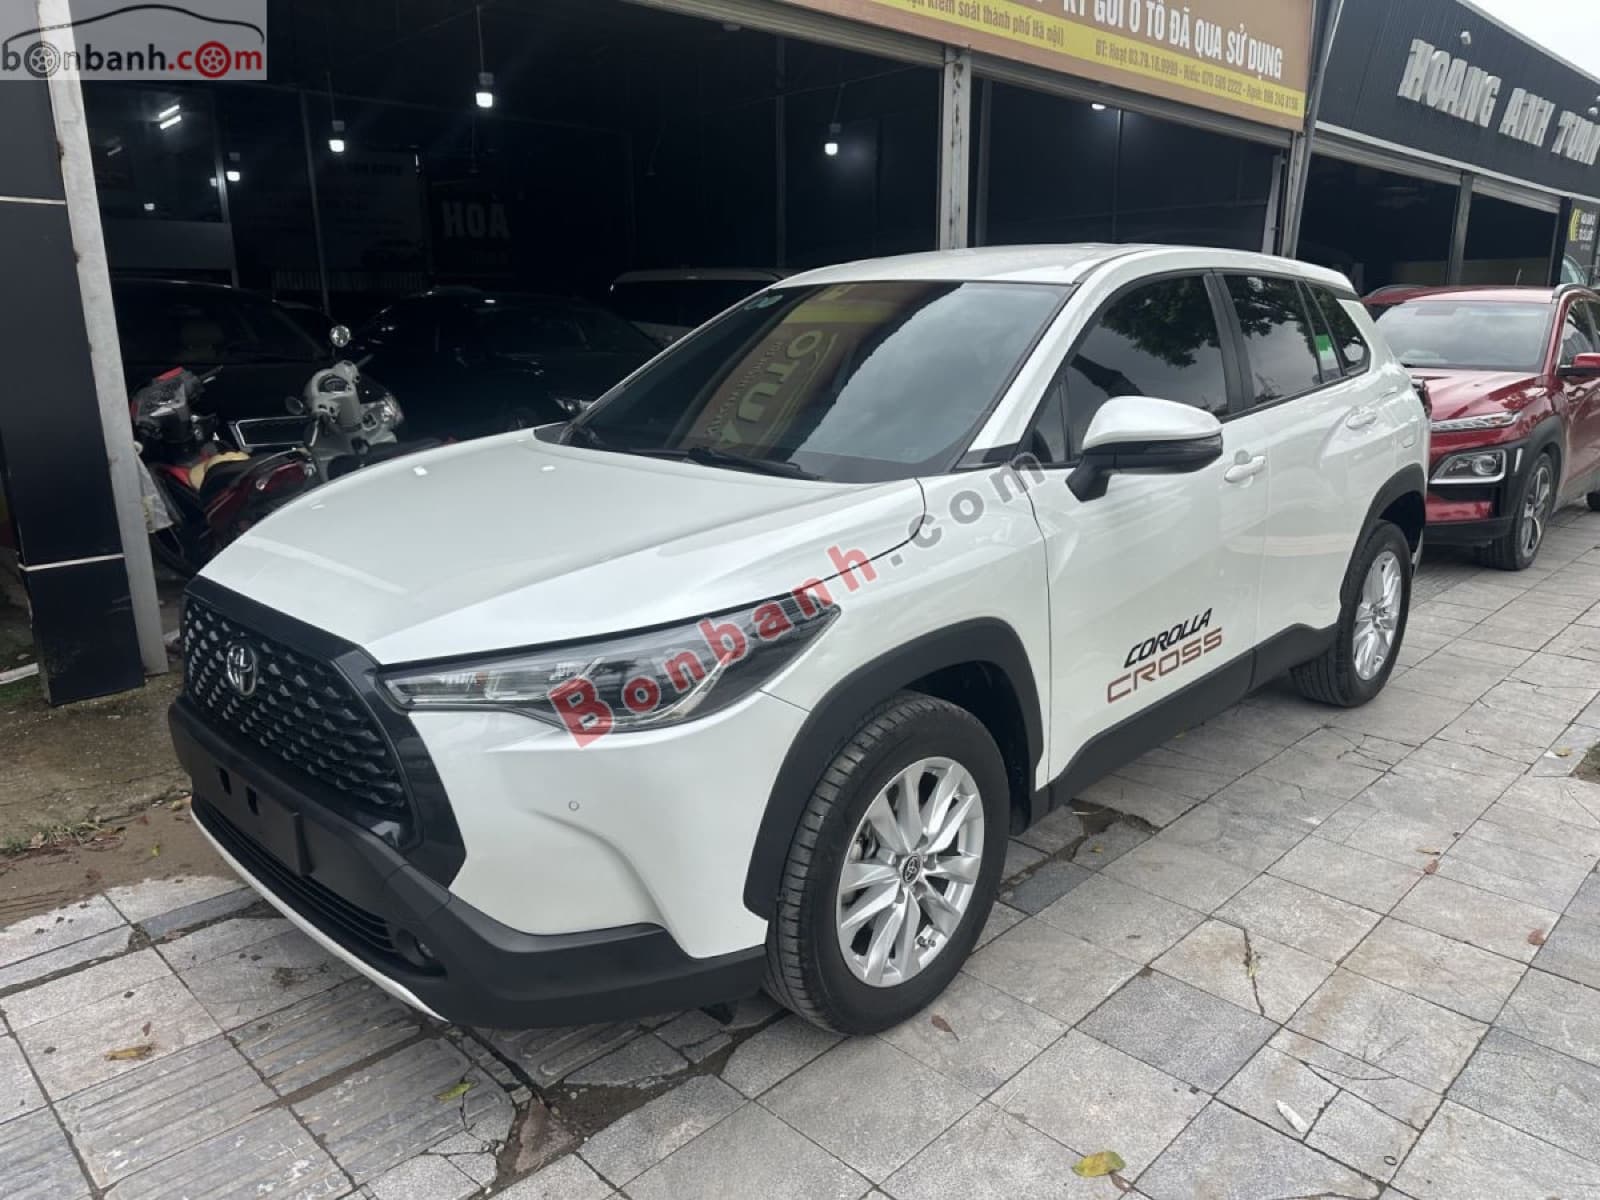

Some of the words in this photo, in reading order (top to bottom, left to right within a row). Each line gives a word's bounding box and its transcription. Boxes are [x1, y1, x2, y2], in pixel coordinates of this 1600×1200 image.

[1169, 6, 1190, 49] ĐÃ
[1195, 18, 1222, 60] QUA
[1226, 23, 1248, 66] SỬ
[1248, 38, 1283, 80] DỤNG
[1397, 39, 1502, 128] HOANG
[1498, 87, 1556, 148] ANH
[1107, 627, 1222, 703] CROSS
[1124, 607, 1213, 668] COROLLA
